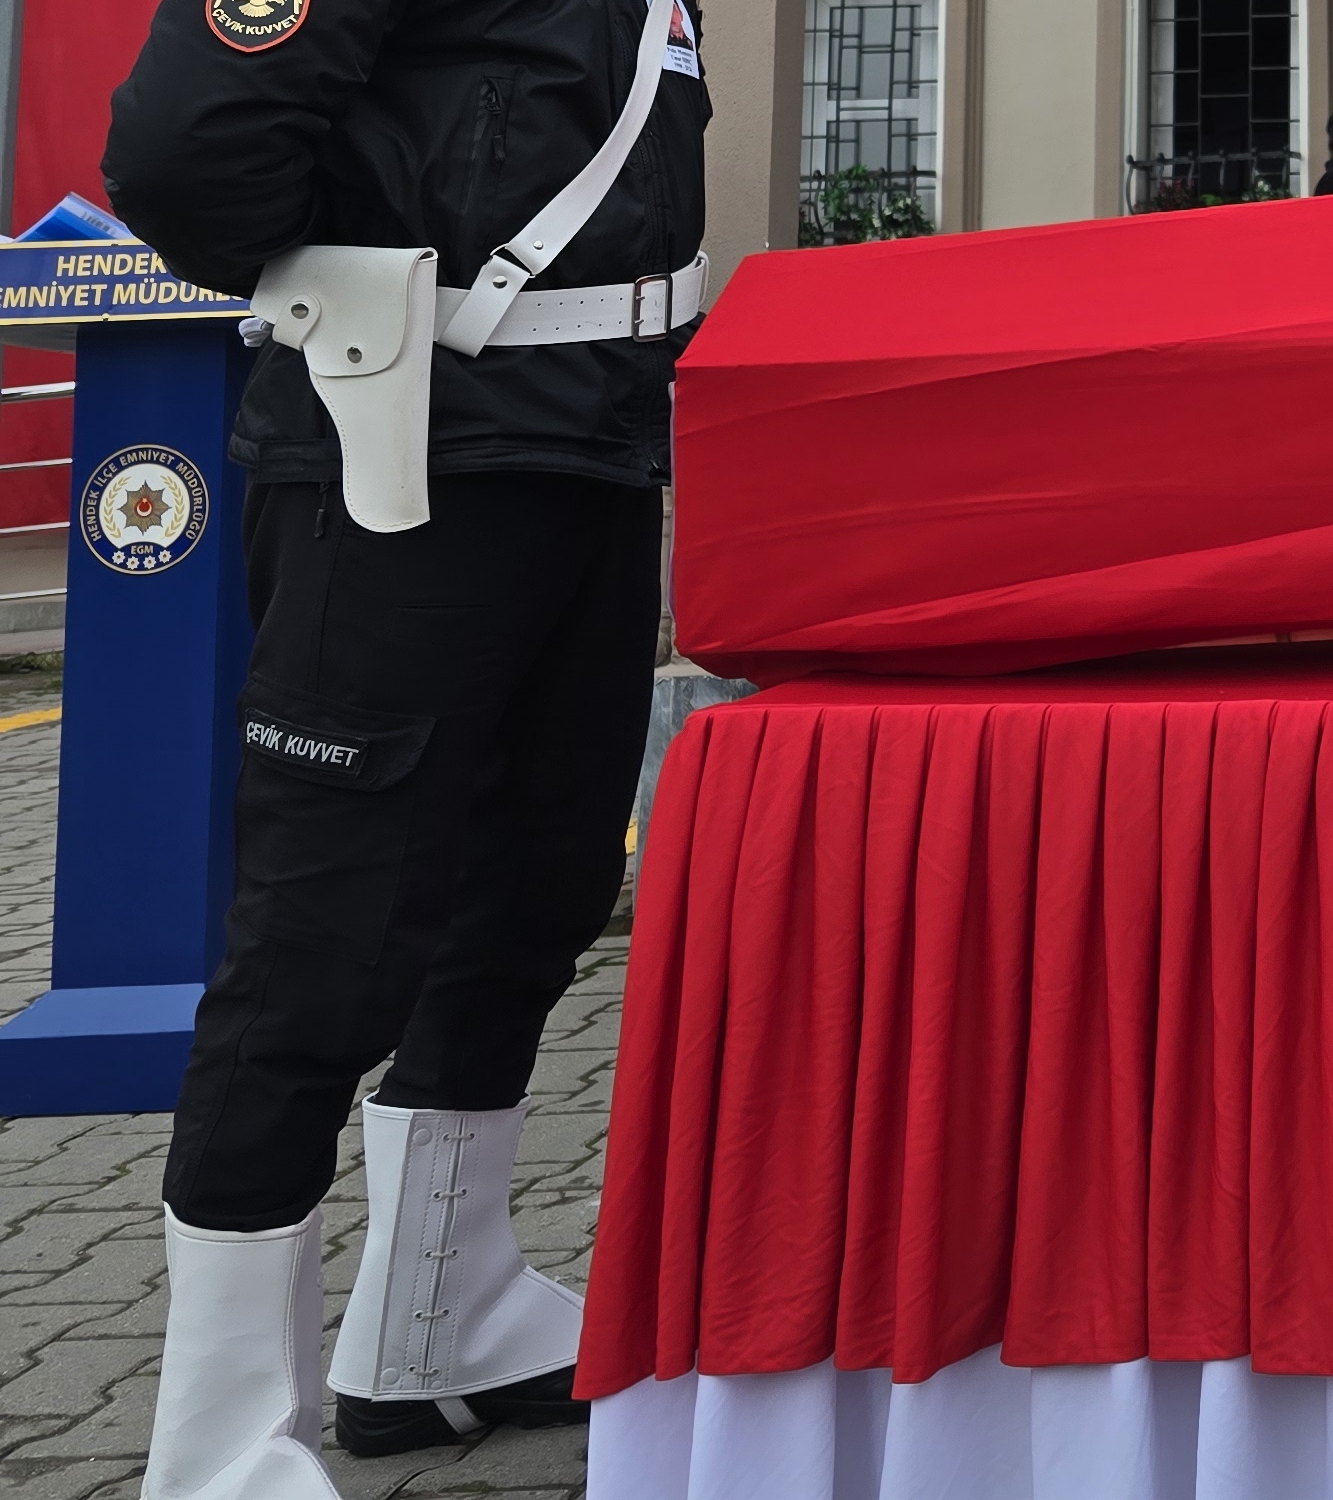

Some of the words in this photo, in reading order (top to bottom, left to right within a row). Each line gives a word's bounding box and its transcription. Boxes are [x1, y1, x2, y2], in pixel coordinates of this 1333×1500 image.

[245, 14, 299, 35] KUVVET
[56, 252, 167, 277] HENDEK
[0, 280, 108, 308] MNİYET
[120, 449, 175, 467] EMNİYET
[93, 462, 118, 487] İLÇE
[86, 489, 102, 542] HENDEK
[130, 545, 154, 555] EGM
[246, 721, 284, 751] ÇEVİK
[284, 734, 360, 767] KUVVET
